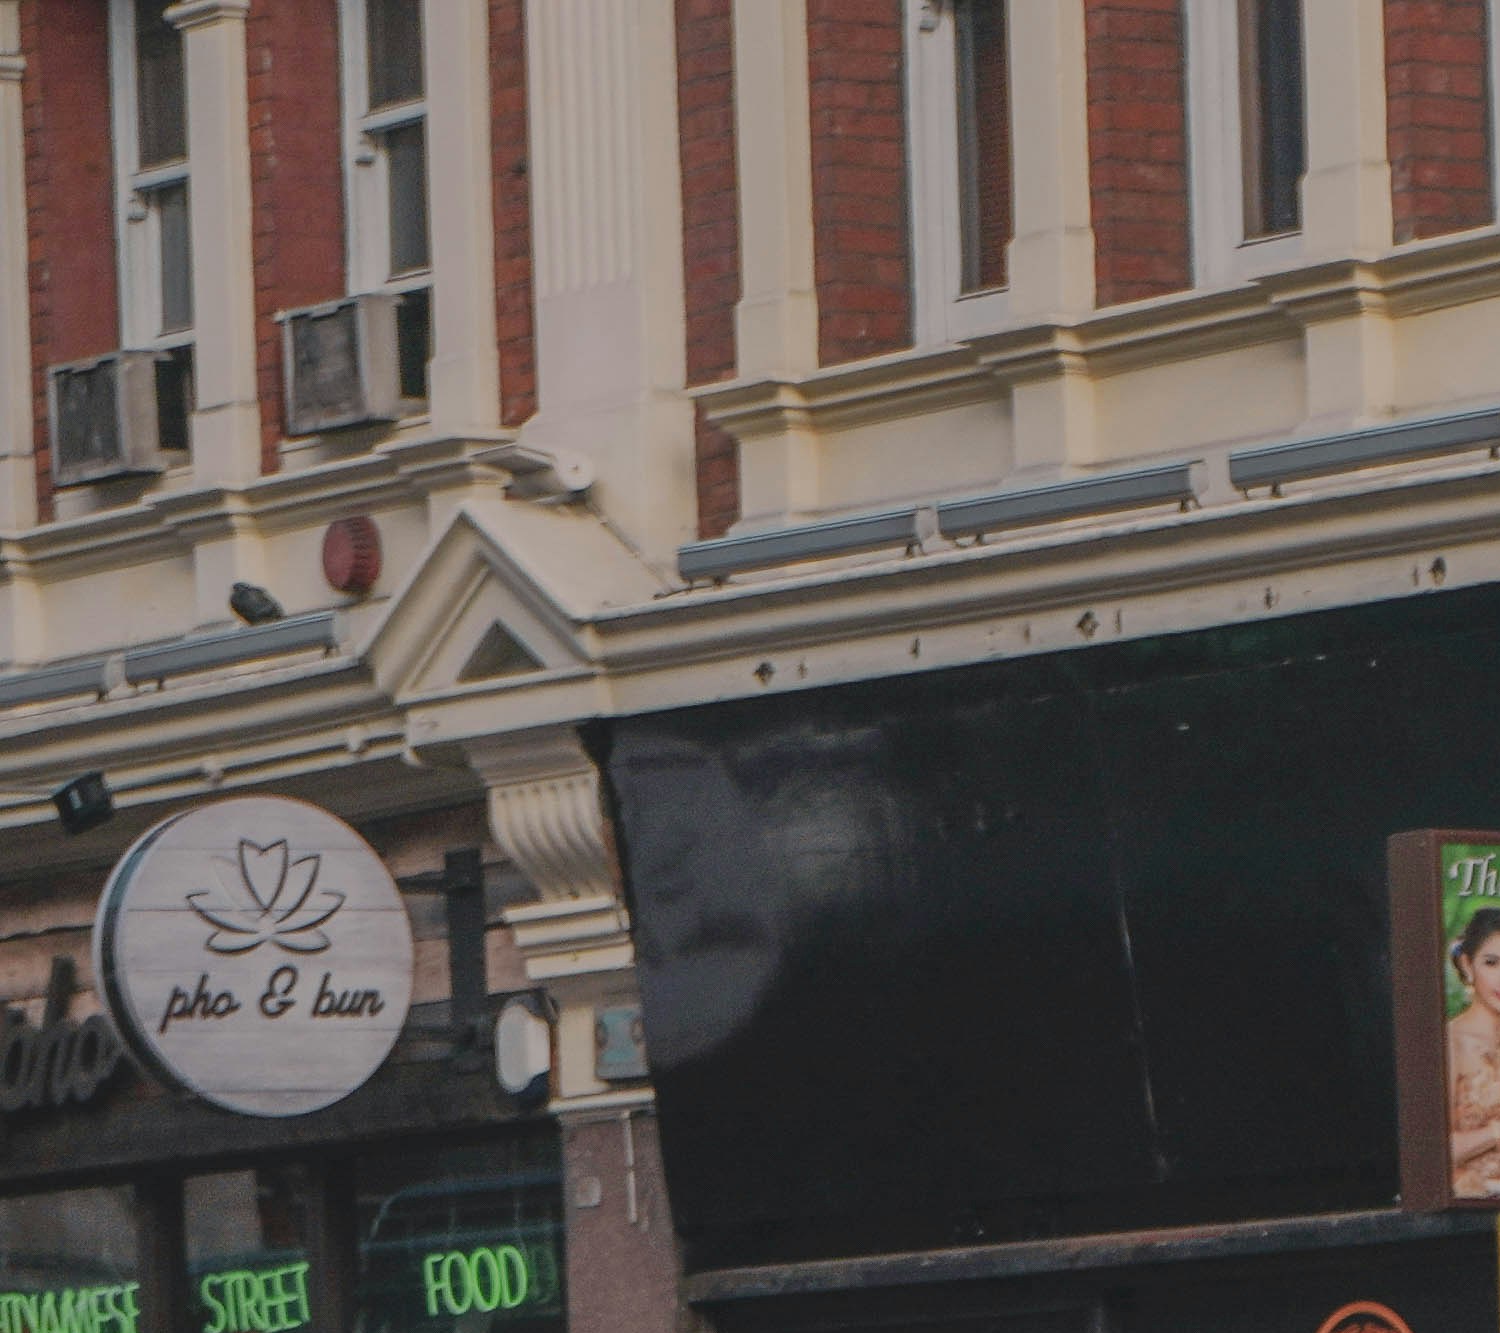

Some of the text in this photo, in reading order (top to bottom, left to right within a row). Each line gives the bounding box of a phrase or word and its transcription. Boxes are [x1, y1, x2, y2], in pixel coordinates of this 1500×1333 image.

[159, 965, 384, 1034] pho & bun
[424, 1245, 529, 1316] FOOD
